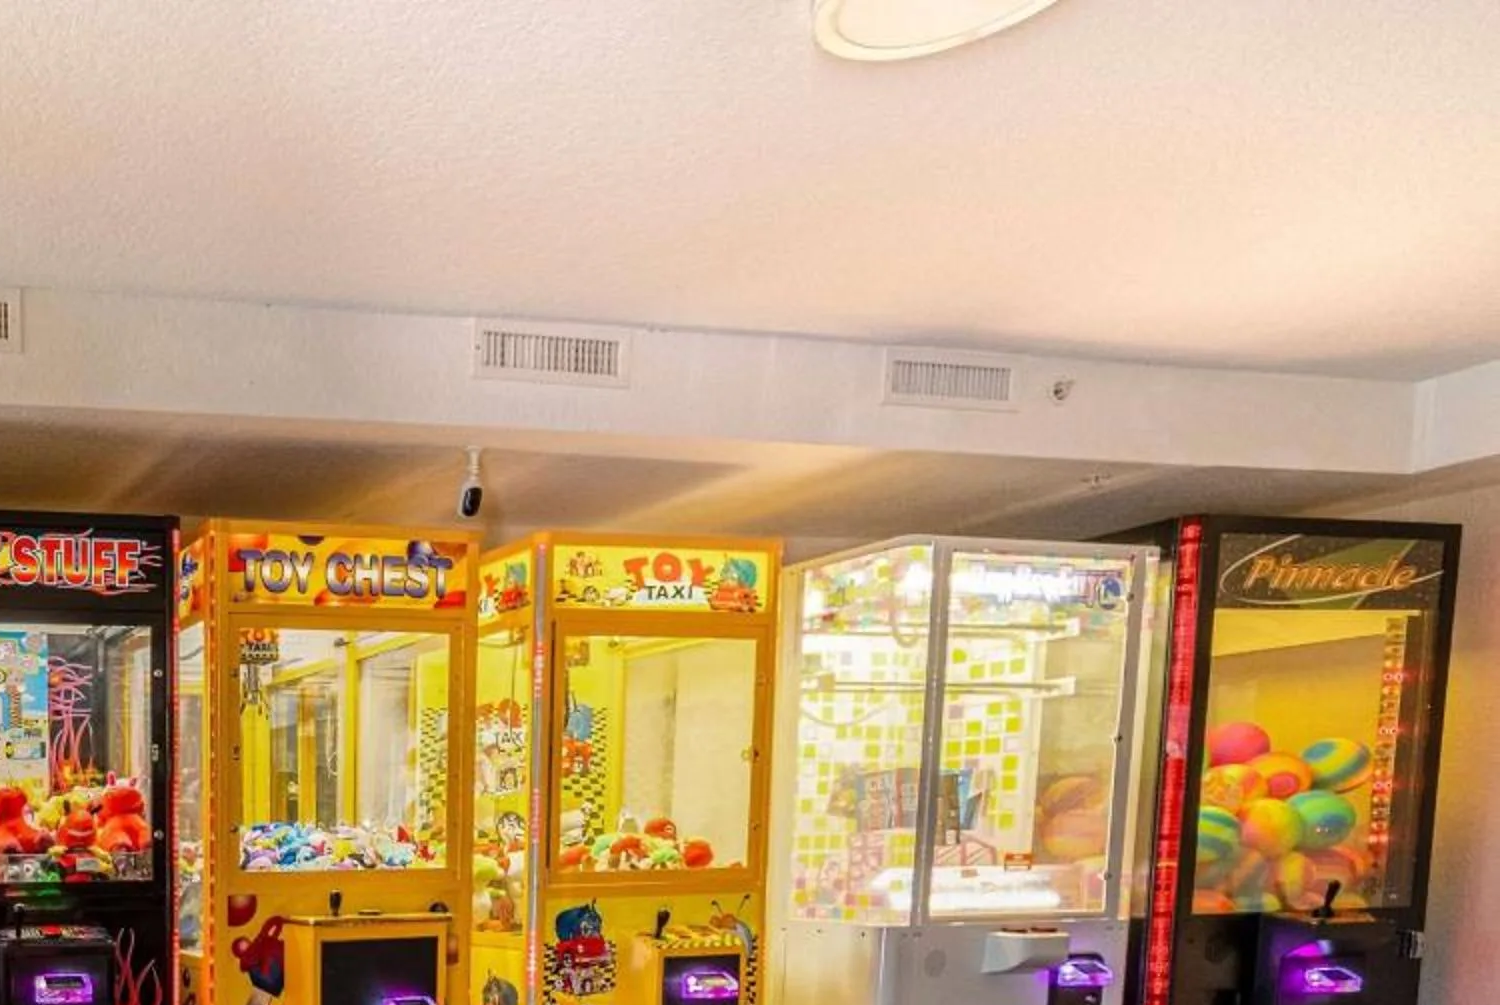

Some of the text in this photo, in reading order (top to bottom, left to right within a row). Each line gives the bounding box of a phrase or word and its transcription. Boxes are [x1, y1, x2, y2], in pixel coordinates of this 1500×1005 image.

[10, 533, 142, 589] STUFF
[238, 548, 453, 599] TOY CHEST
[623, 551, 715, 591] TOY
[1242, 554, 1418, 593] Pinnacle
[644, 584, 695, 601] TAXI
